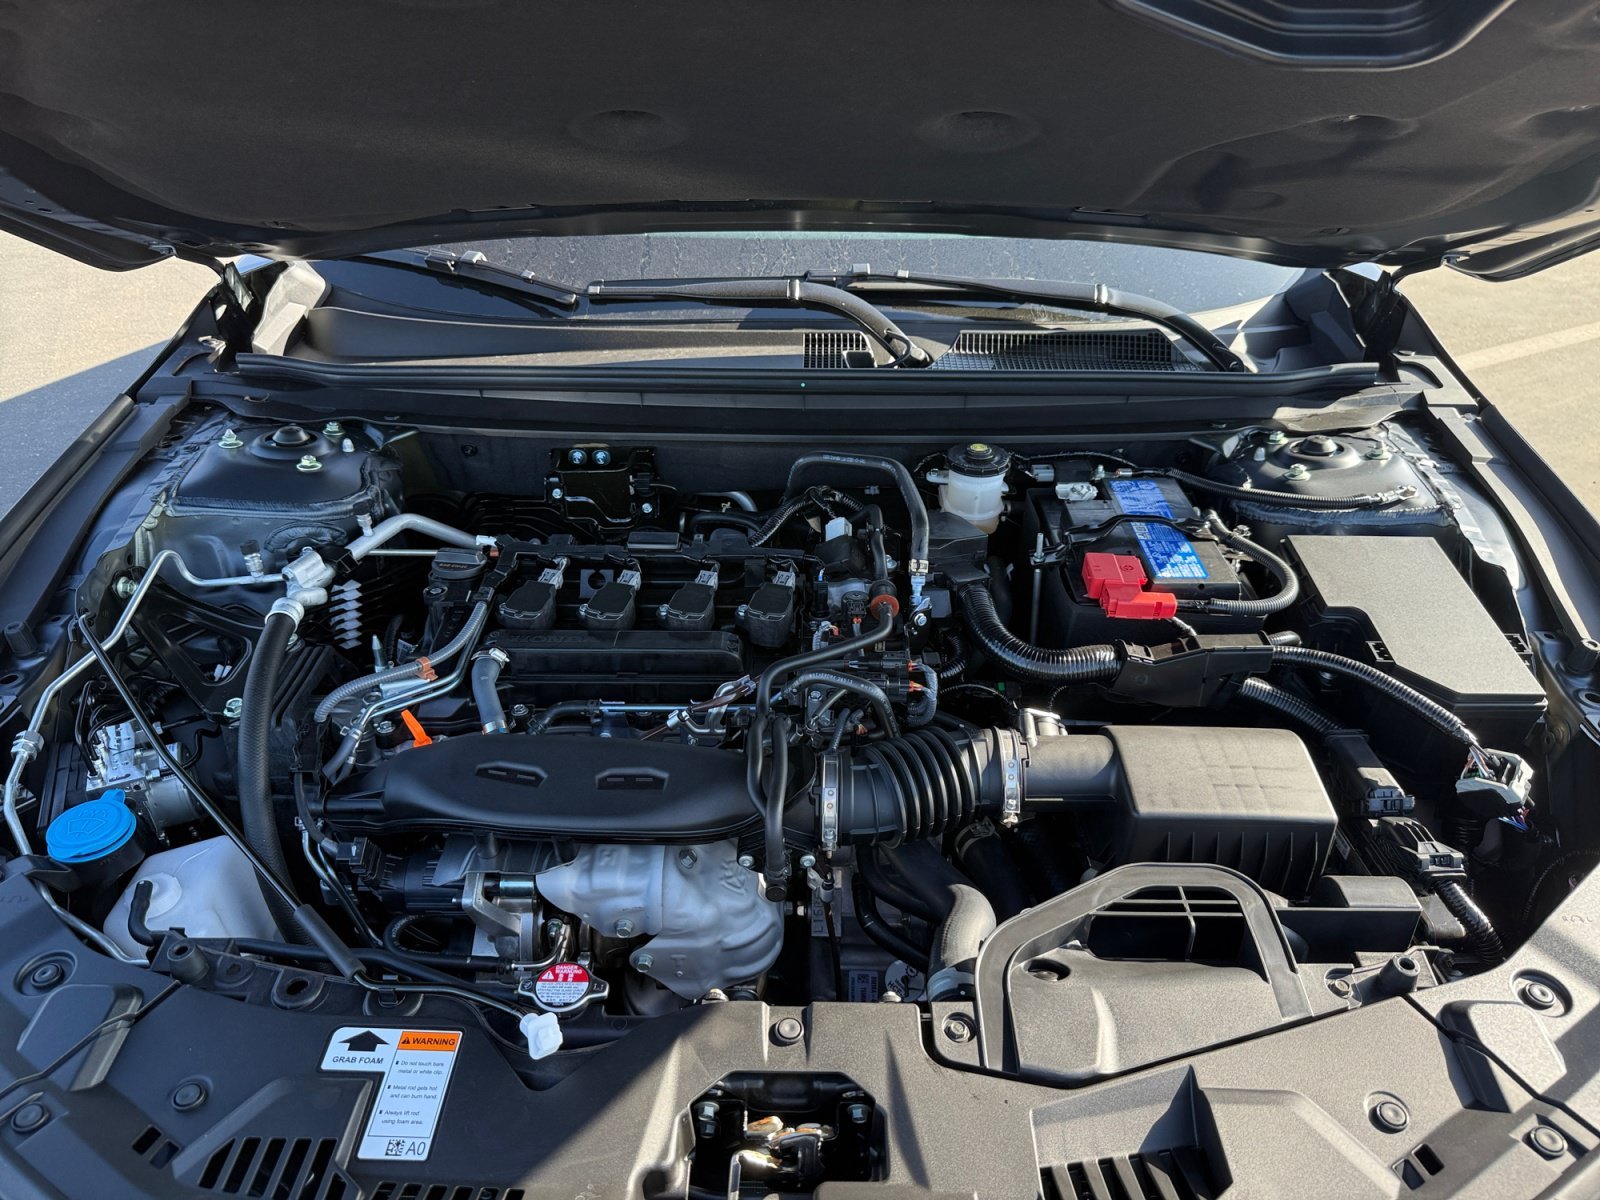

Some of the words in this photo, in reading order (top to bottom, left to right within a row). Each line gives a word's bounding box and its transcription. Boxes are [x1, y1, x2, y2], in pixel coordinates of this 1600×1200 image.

[412, 1037, 456, 1046] WARNING
[332, 1055, 357, 1063] GRAB
[358, 1056, 384, 1064] FOAM
